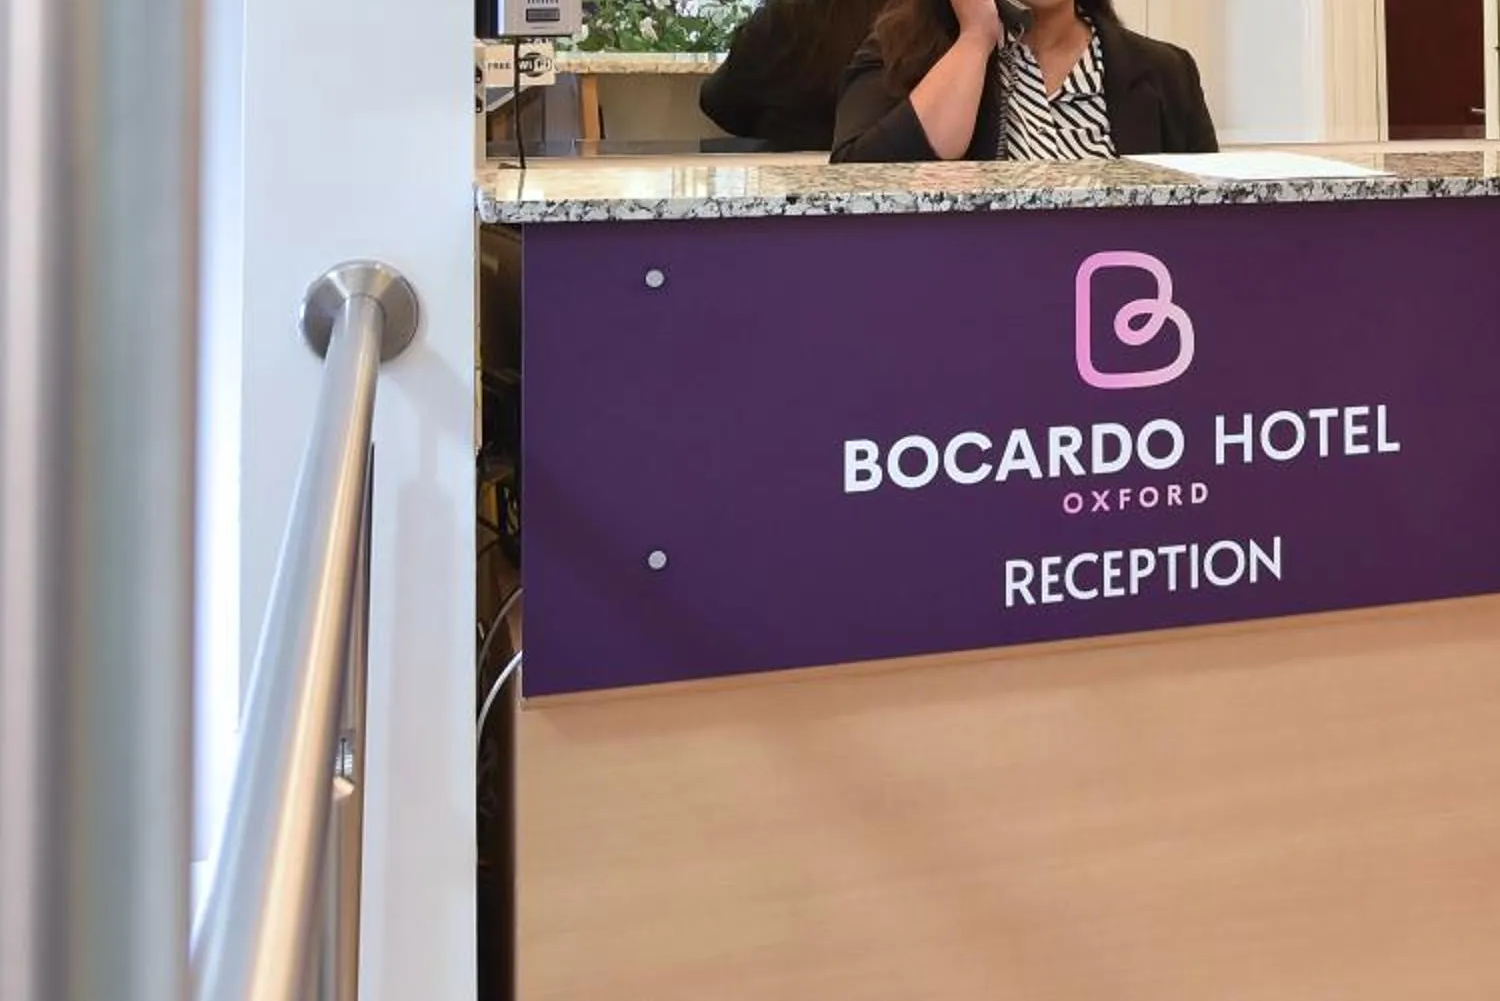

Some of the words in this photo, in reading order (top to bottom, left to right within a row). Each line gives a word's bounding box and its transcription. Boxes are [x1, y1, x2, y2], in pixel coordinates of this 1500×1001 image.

[844, 419, 1185, 492] BOCARDO
[1215, 404, 1401, 465] HOTEL
[1063, 482, 1209, 514] OXFORD
[1005, 536, 1281, 607] RECEPTION
